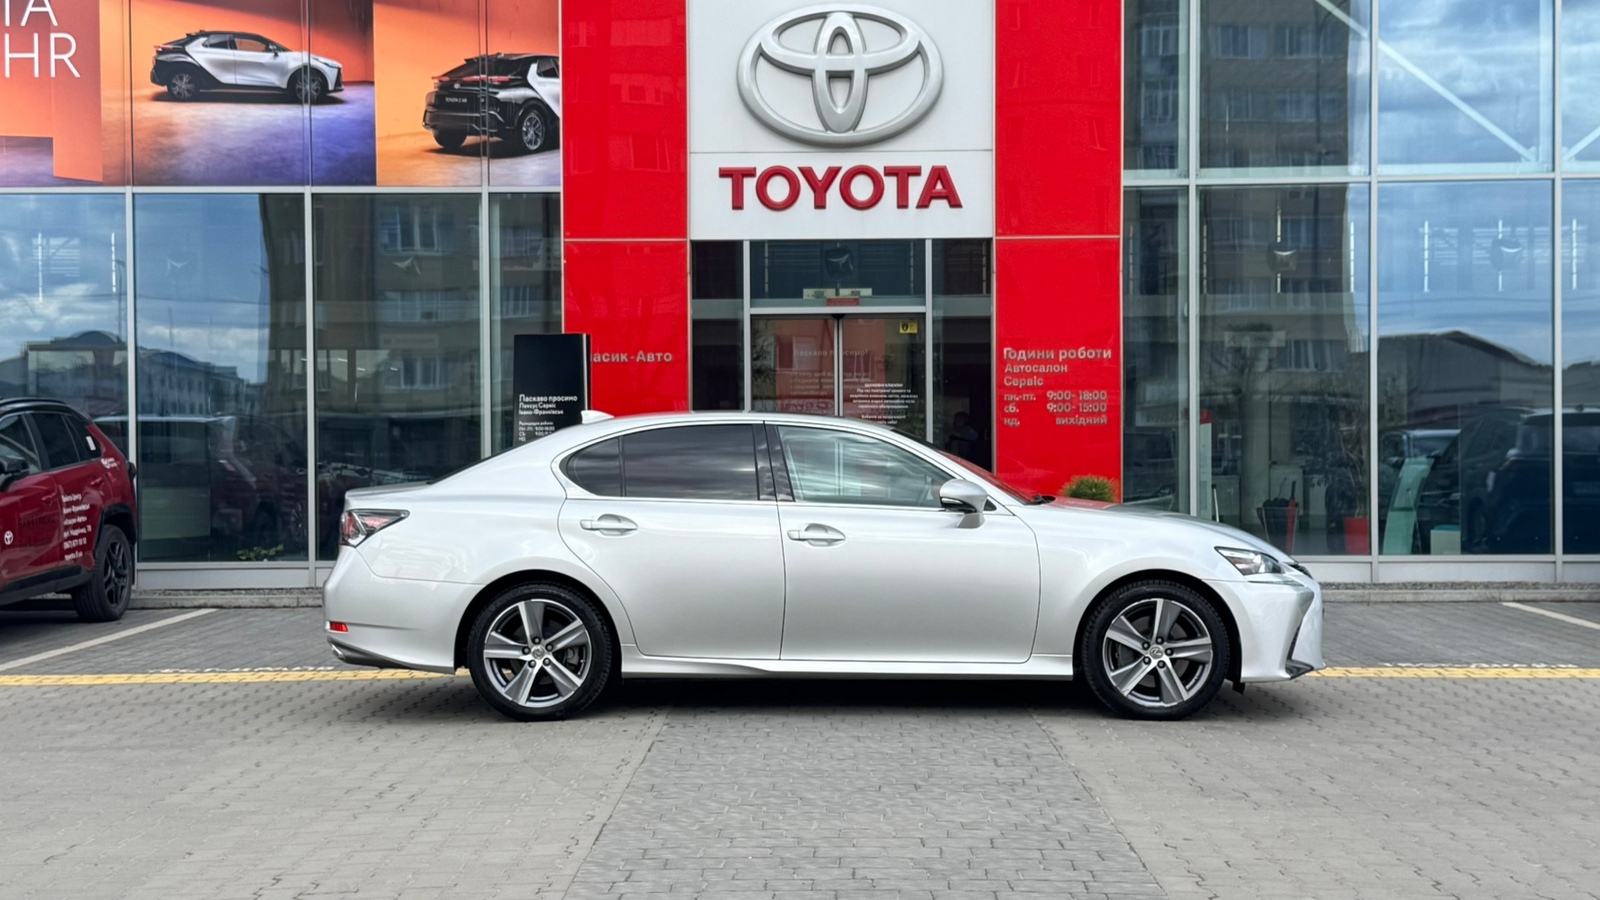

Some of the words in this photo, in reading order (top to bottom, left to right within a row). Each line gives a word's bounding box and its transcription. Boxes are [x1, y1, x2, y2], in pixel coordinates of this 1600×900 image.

[4, 32, 81, 79] HR
[718, 164, 963, 211] TOYOTA
[1003, 347, 1055, 361] Години
[1058, 346, 1112, 362] роботи
[1004, 364, 1068, 373] Автосалон
[1003, 376, 1044, 388] Сервіс
[1056, 415, 1107, 426] вихідний
